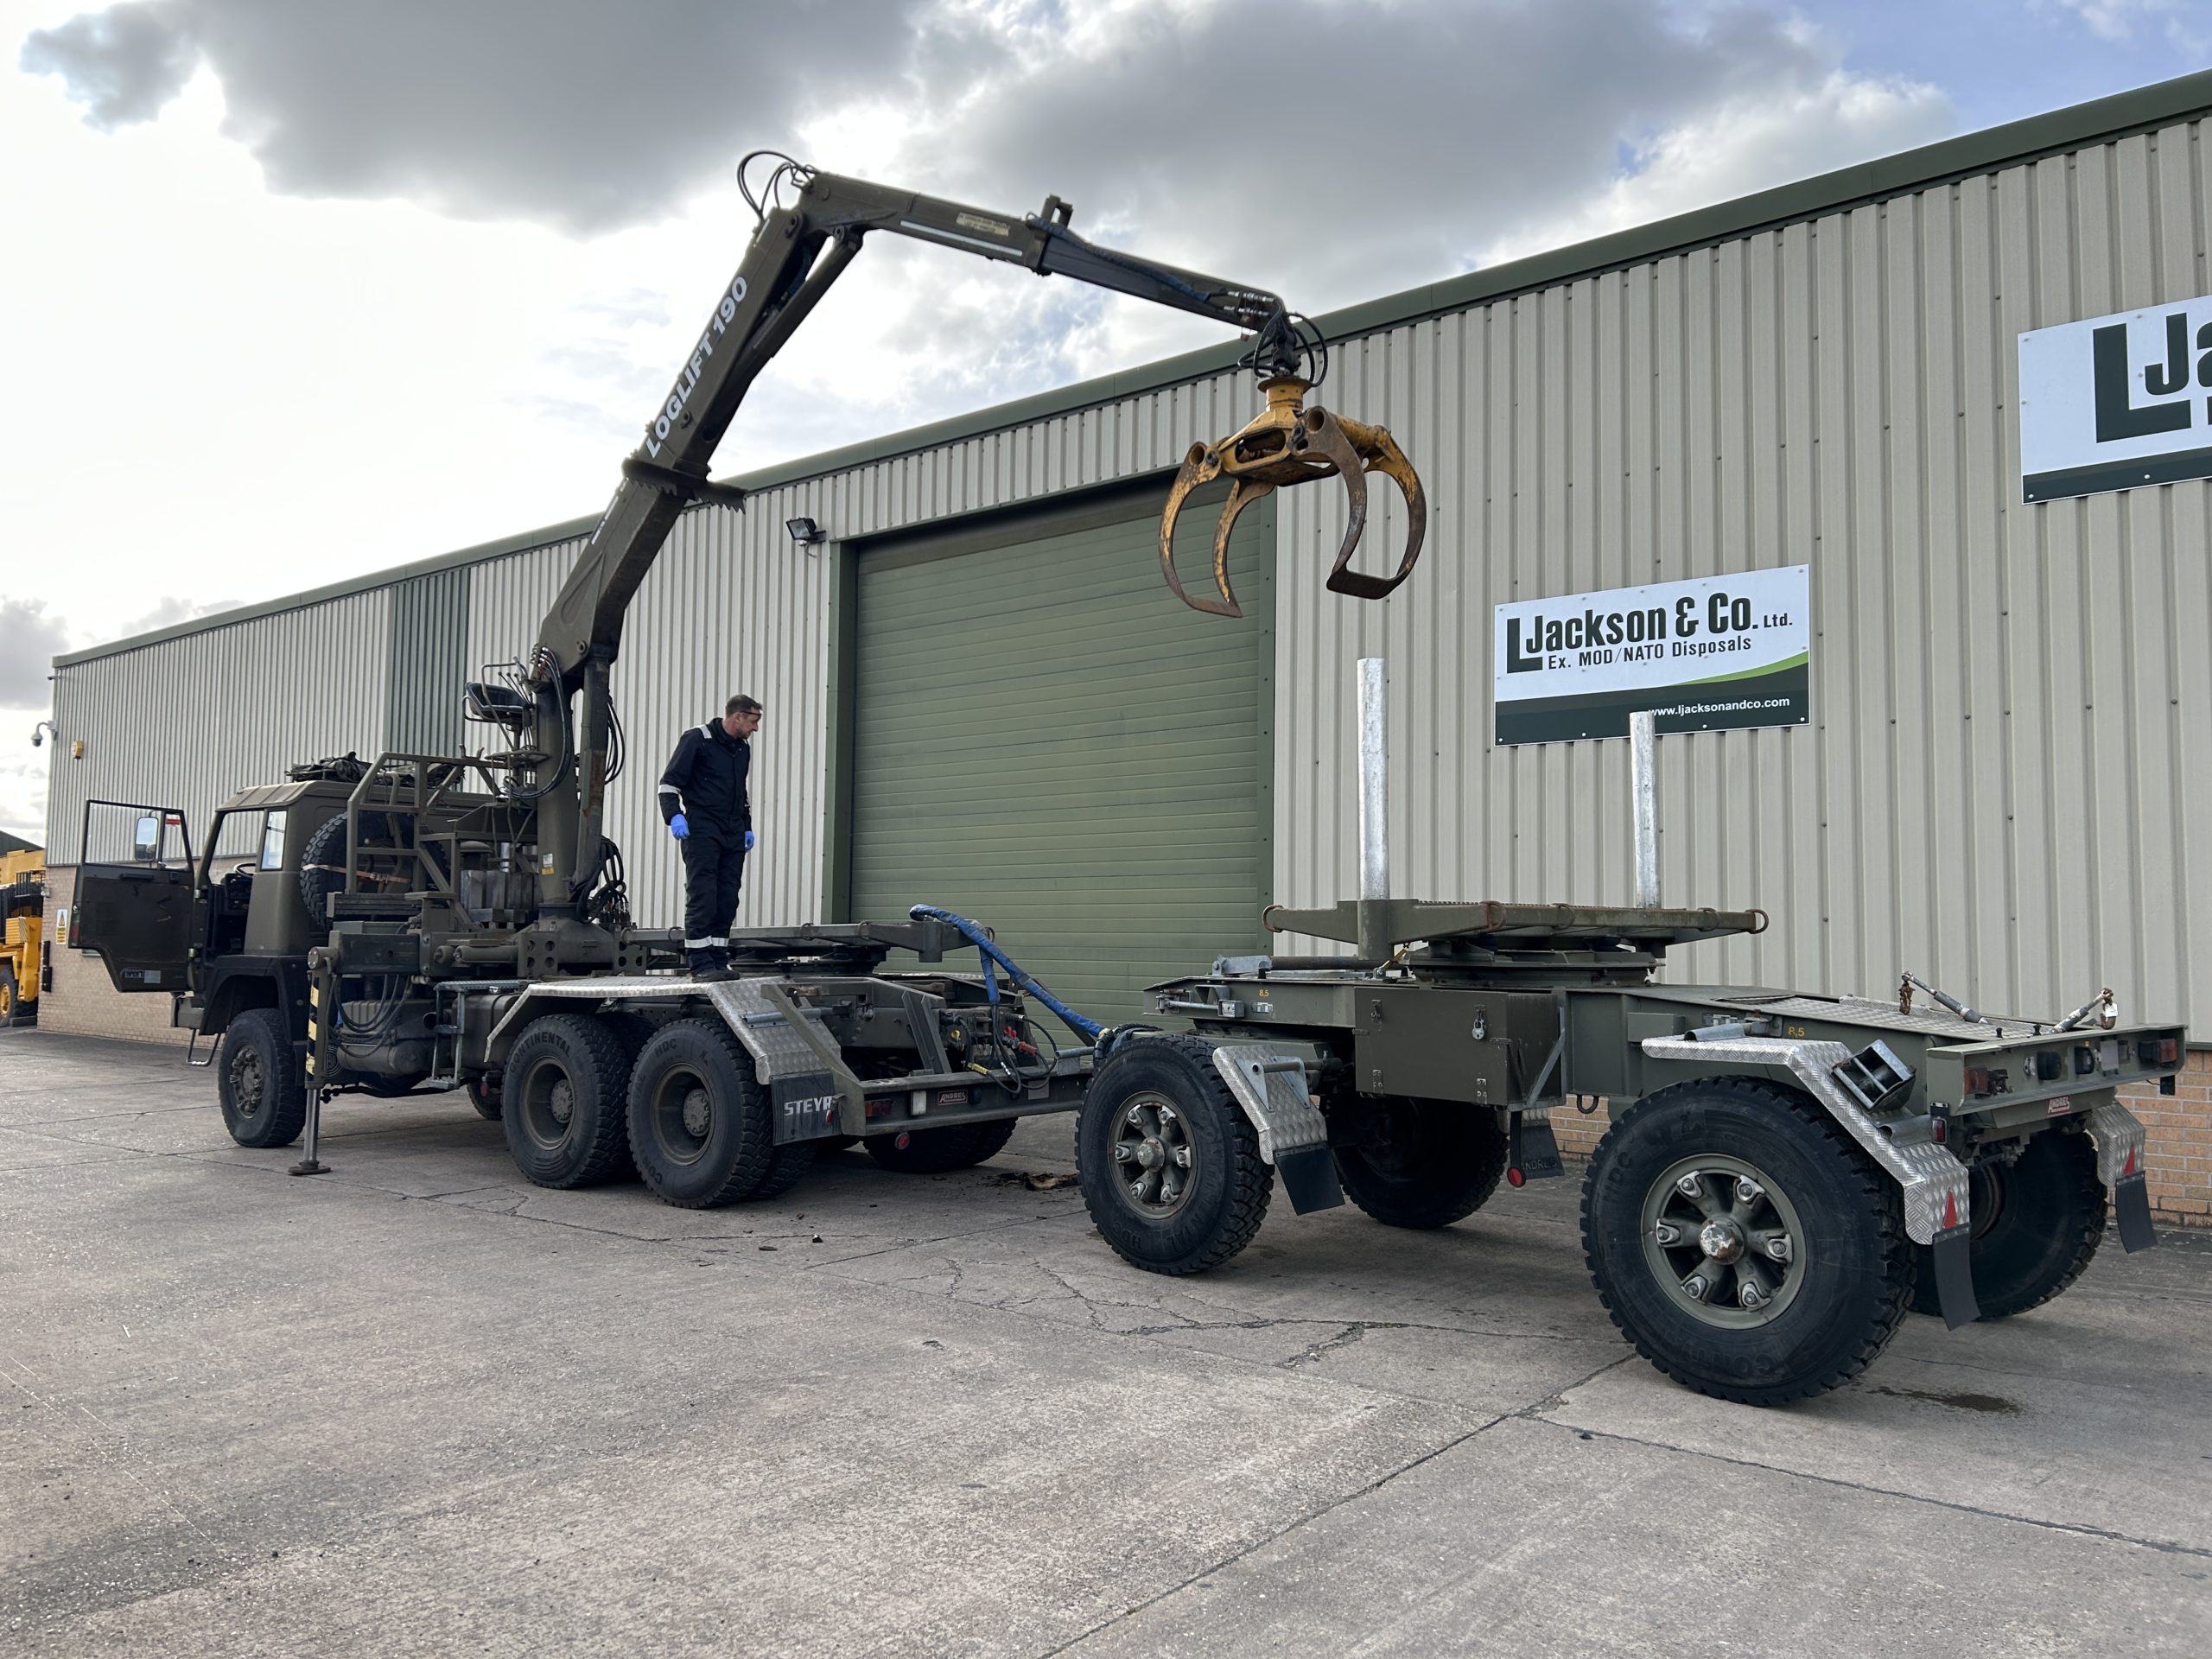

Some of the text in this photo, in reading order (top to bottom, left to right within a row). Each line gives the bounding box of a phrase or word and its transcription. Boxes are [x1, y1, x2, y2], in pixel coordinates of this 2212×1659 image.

[646, 276, 747, 459] LOGLIFT 190
[1675, 596, 1700, 638] &
[1708, 592, 1758, 634] Co.
[1764, 613, 1793, 628] Ltd.
[1548, 654, 1571, 670] Ex.
[1672, 635, 1751, 658] Disposals
[510, 1031, 571, 1073] CONTINENTAL
[654, 1038, 677, 1058] HDC
[939, 1091, 966, 1103] ANDRES
